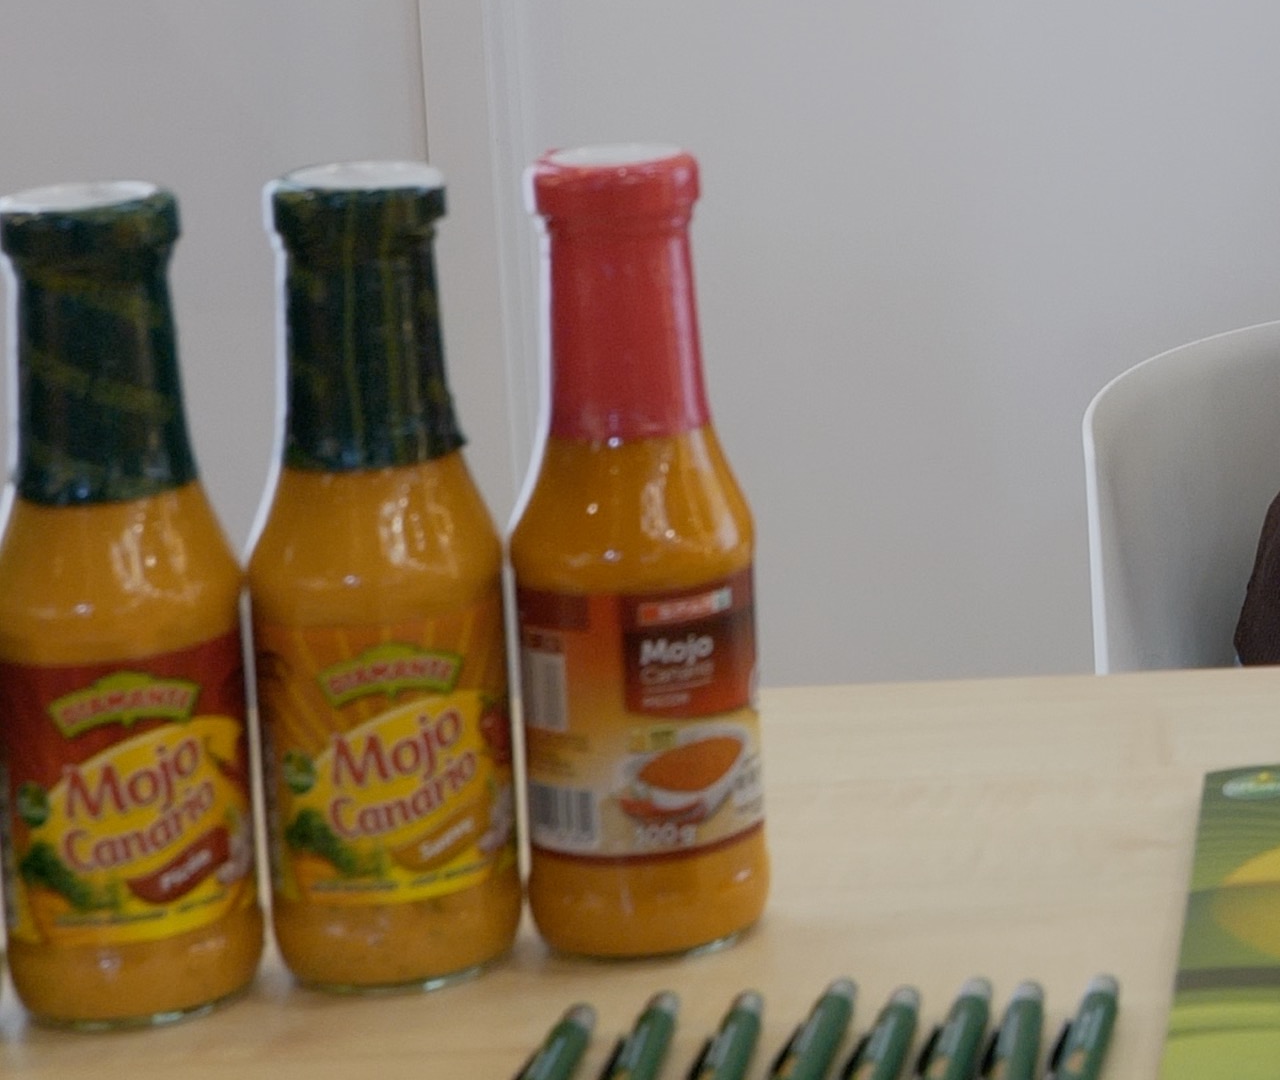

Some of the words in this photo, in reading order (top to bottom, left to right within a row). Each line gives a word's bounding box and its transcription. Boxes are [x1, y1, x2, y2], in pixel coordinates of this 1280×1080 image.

[640, 632, 714, 666] Mojo
[64, 733, 200, 820] Mojo
[330, 708, 463, 788] Mojo
[62, 777, 215, 874] Canario
[328, 750, 476, 840] Canario
